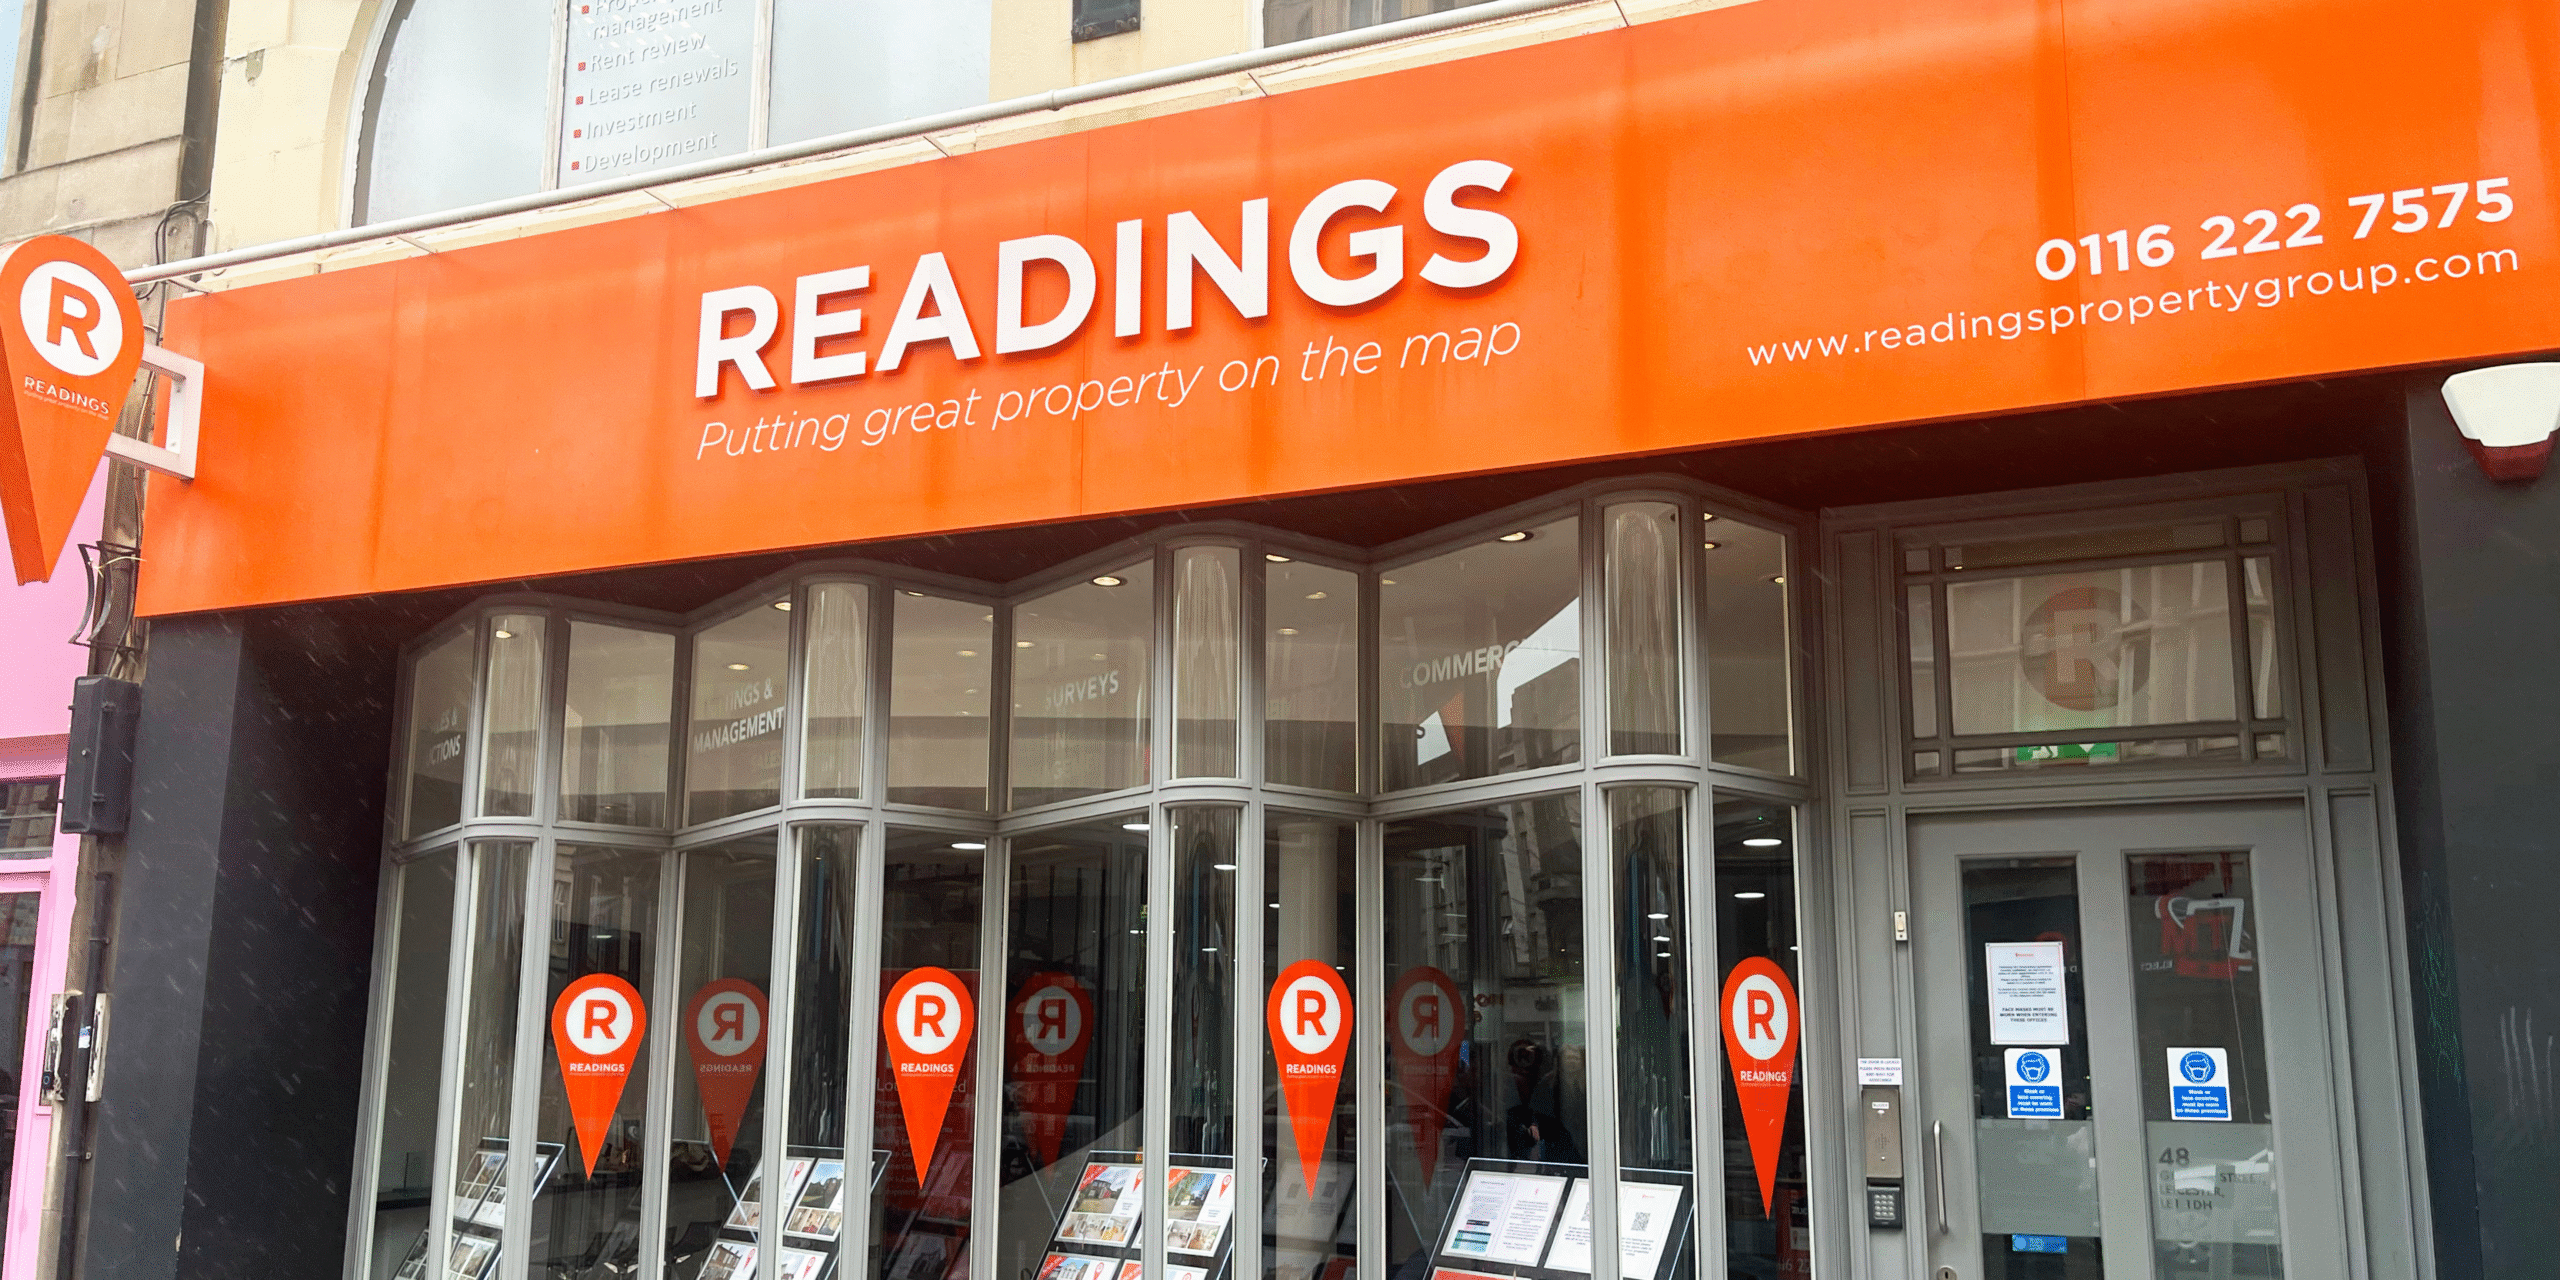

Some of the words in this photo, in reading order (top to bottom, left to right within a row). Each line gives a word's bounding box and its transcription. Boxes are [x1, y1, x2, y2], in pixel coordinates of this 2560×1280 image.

[593, 0, 723, 40] management
[591, 48, 635, 73] Rent
[641, 34, 707, 62] review
[589, 82, 642, 106] Lease
[649, 57, 739, 94] renewals
[586, 101, 697, 140] Investment
[585, 131, 718, 173] Development
[2035, 223, 2175, 281] 0116
[2200, 202, 2324, 260] 222
[2347, 176, 2514, 240] 7575
[695, 158, 1520, 400] READINGS
[46, 276, 101, 361] R
[1747, 248, 2519, 367] www.readingspropertygroup.com
[24, 375, 109, 415] READINGS
[696, 410, 850, 461] Putting
[861, 387, 982, 447] great
[992, 361, 1205, 431] property
[1218, 354, 1281, 393] on
[1300, 335, 1383, 383] the
[1399, 320, 1522, 370] map
[693, 706, 786, 754] MANAGEMENT
[583, 999, 618, 1040] R
[913, 994, 945, 1038] R
[1296, 989, 1327, 1036] R
[1746, 989, 1777, 1041] R
[570, 1063, 625, 1073] READINGS
[900, 1063, 954, 1074] READINGS
[1286, 1063, 1337, 1074] READINGS
[1740, 1070, 1787, 1082] READINGS
[2158, 1147, 2190, 1168] 48
[2186, 1199, 2213, 1211] 1DH
